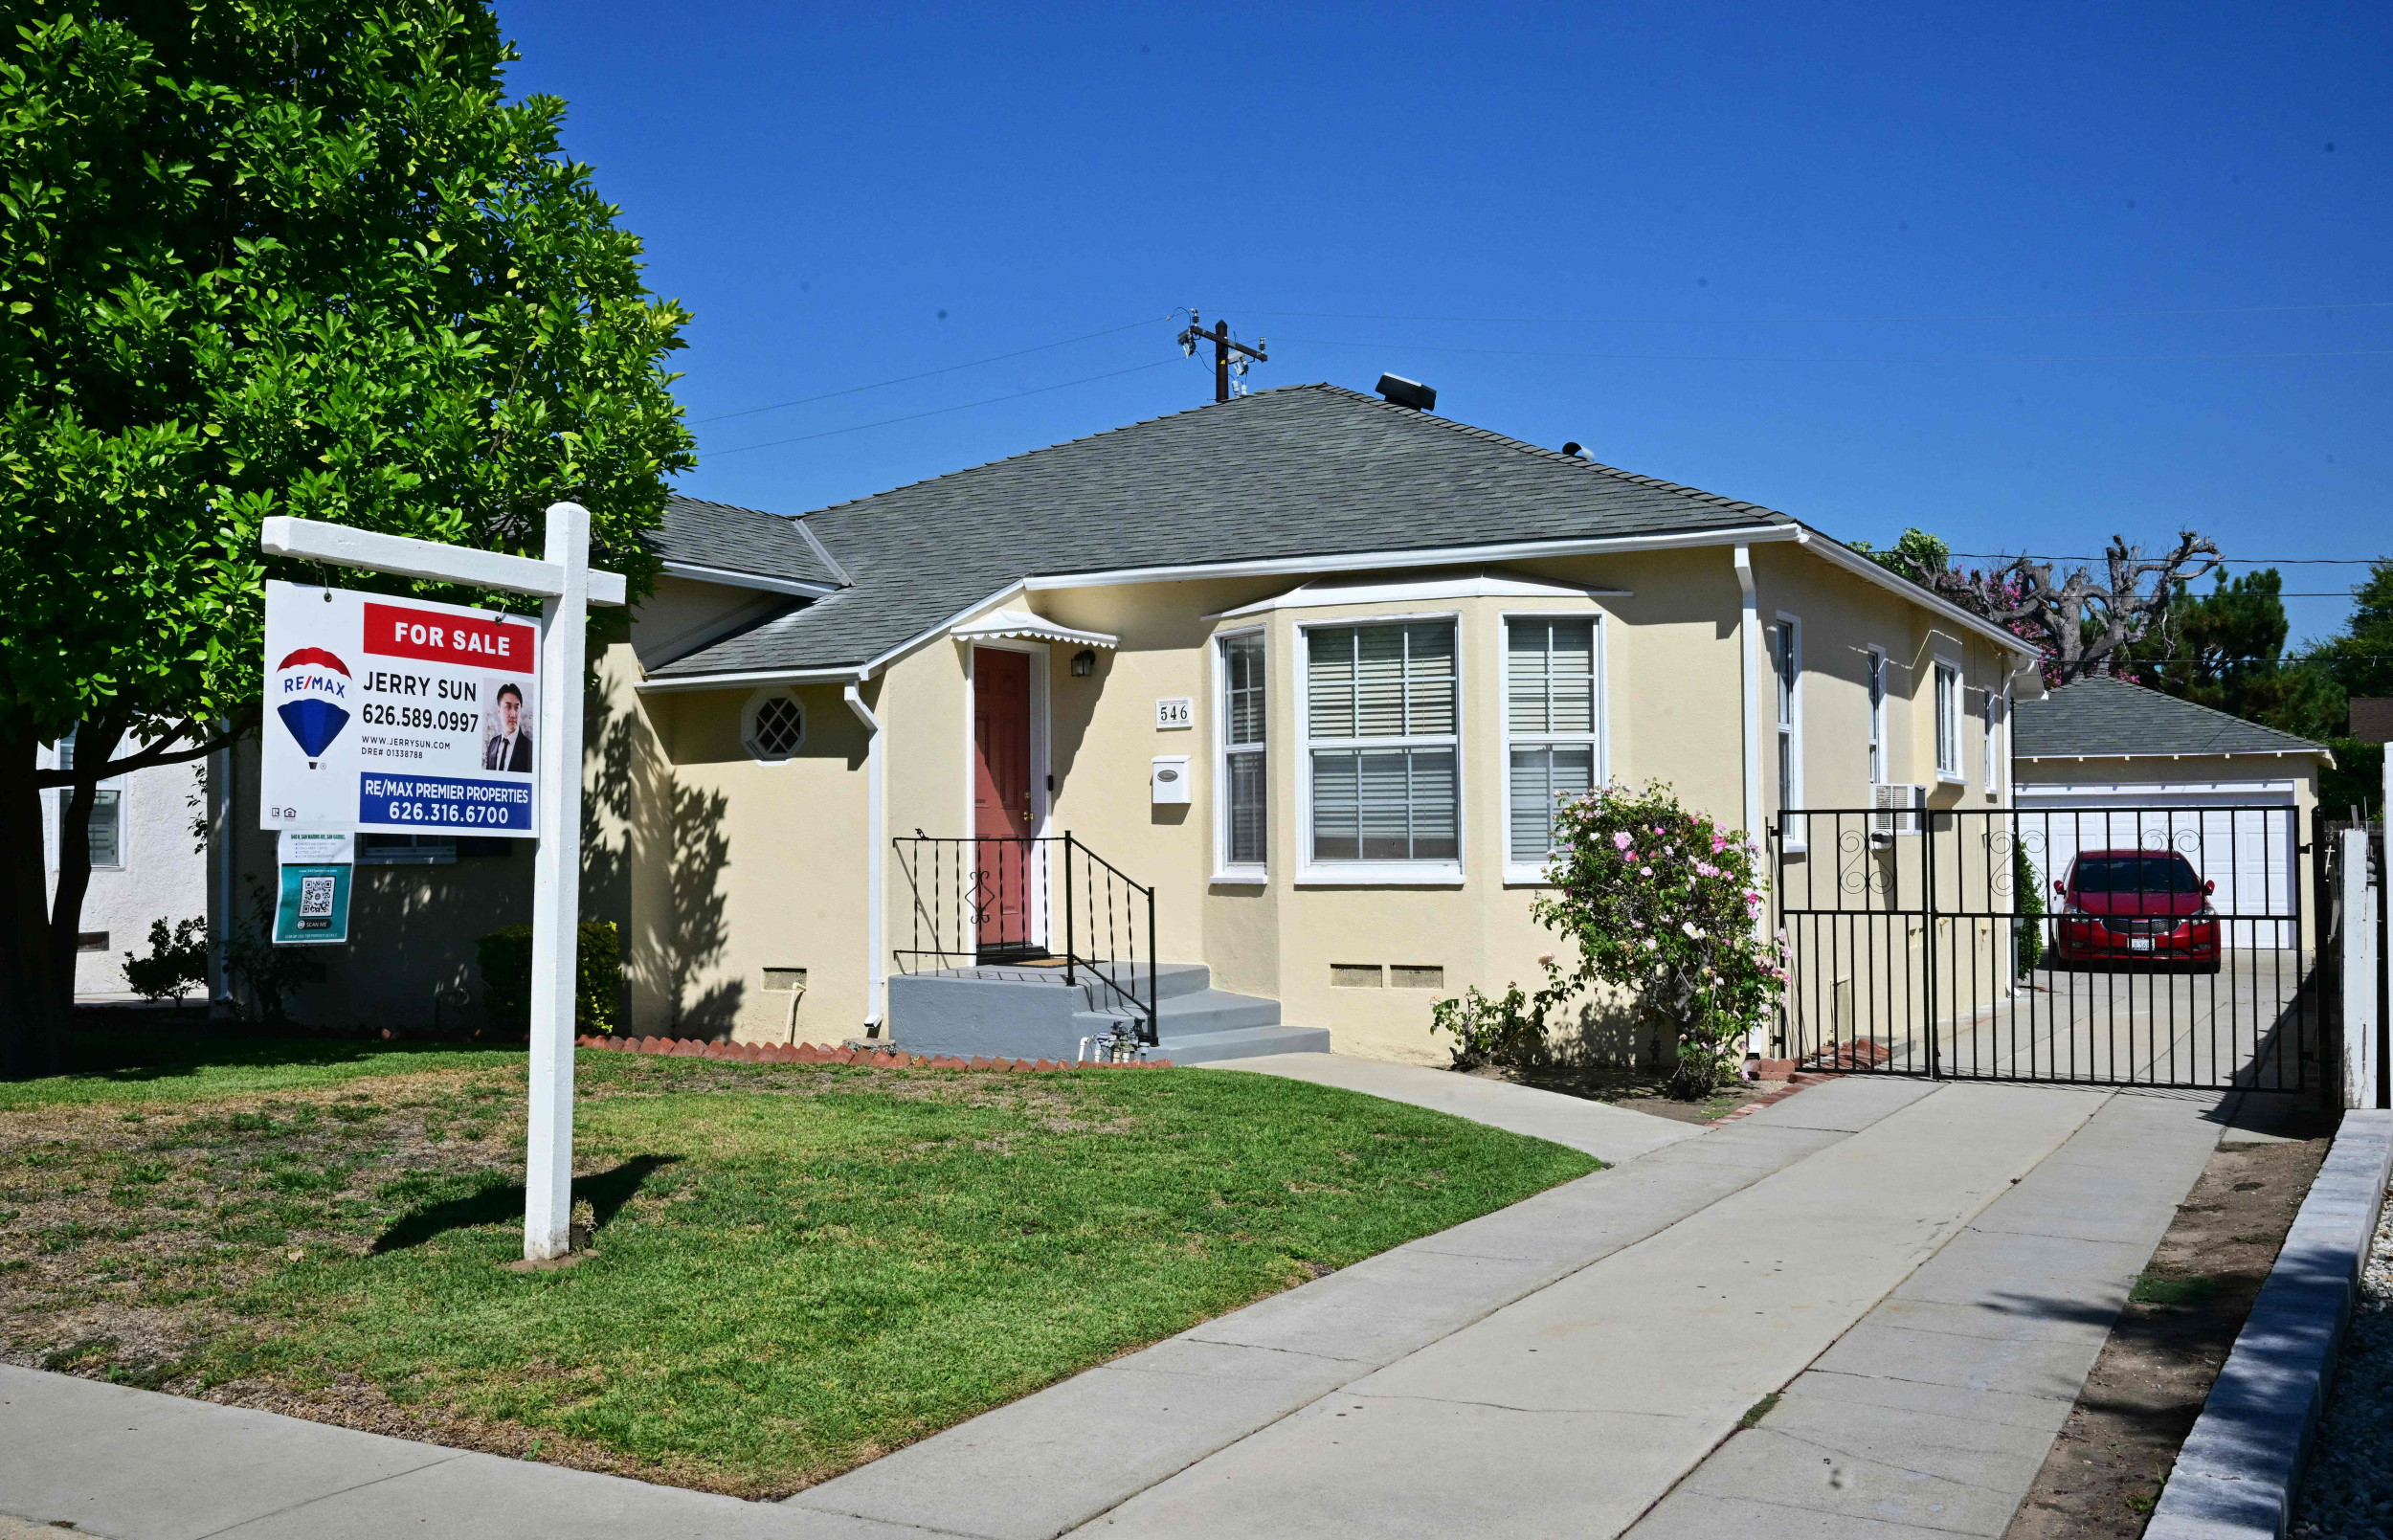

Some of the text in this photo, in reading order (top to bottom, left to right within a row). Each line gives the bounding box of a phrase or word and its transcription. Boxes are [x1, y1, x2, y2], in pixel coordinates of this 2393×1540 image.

[394, 622, 510, 657] FOR SALE
[284, 676, 346, 699] RE/MAX
[363, 672, 477, 702] JERRY SUN
[363, 703, 479, 732] 626.589.0997
[1161, 705, 1188, 721] 546
[361, 748, 423, 759] DRE# 01338788
[362, 735, 451, 749] WWW.JERRYSUN.COM
[365, 779, 528, 804] RE/MAX PREMIER PROPERTIES
[389, 802, 509, 824] 626.316.6700
